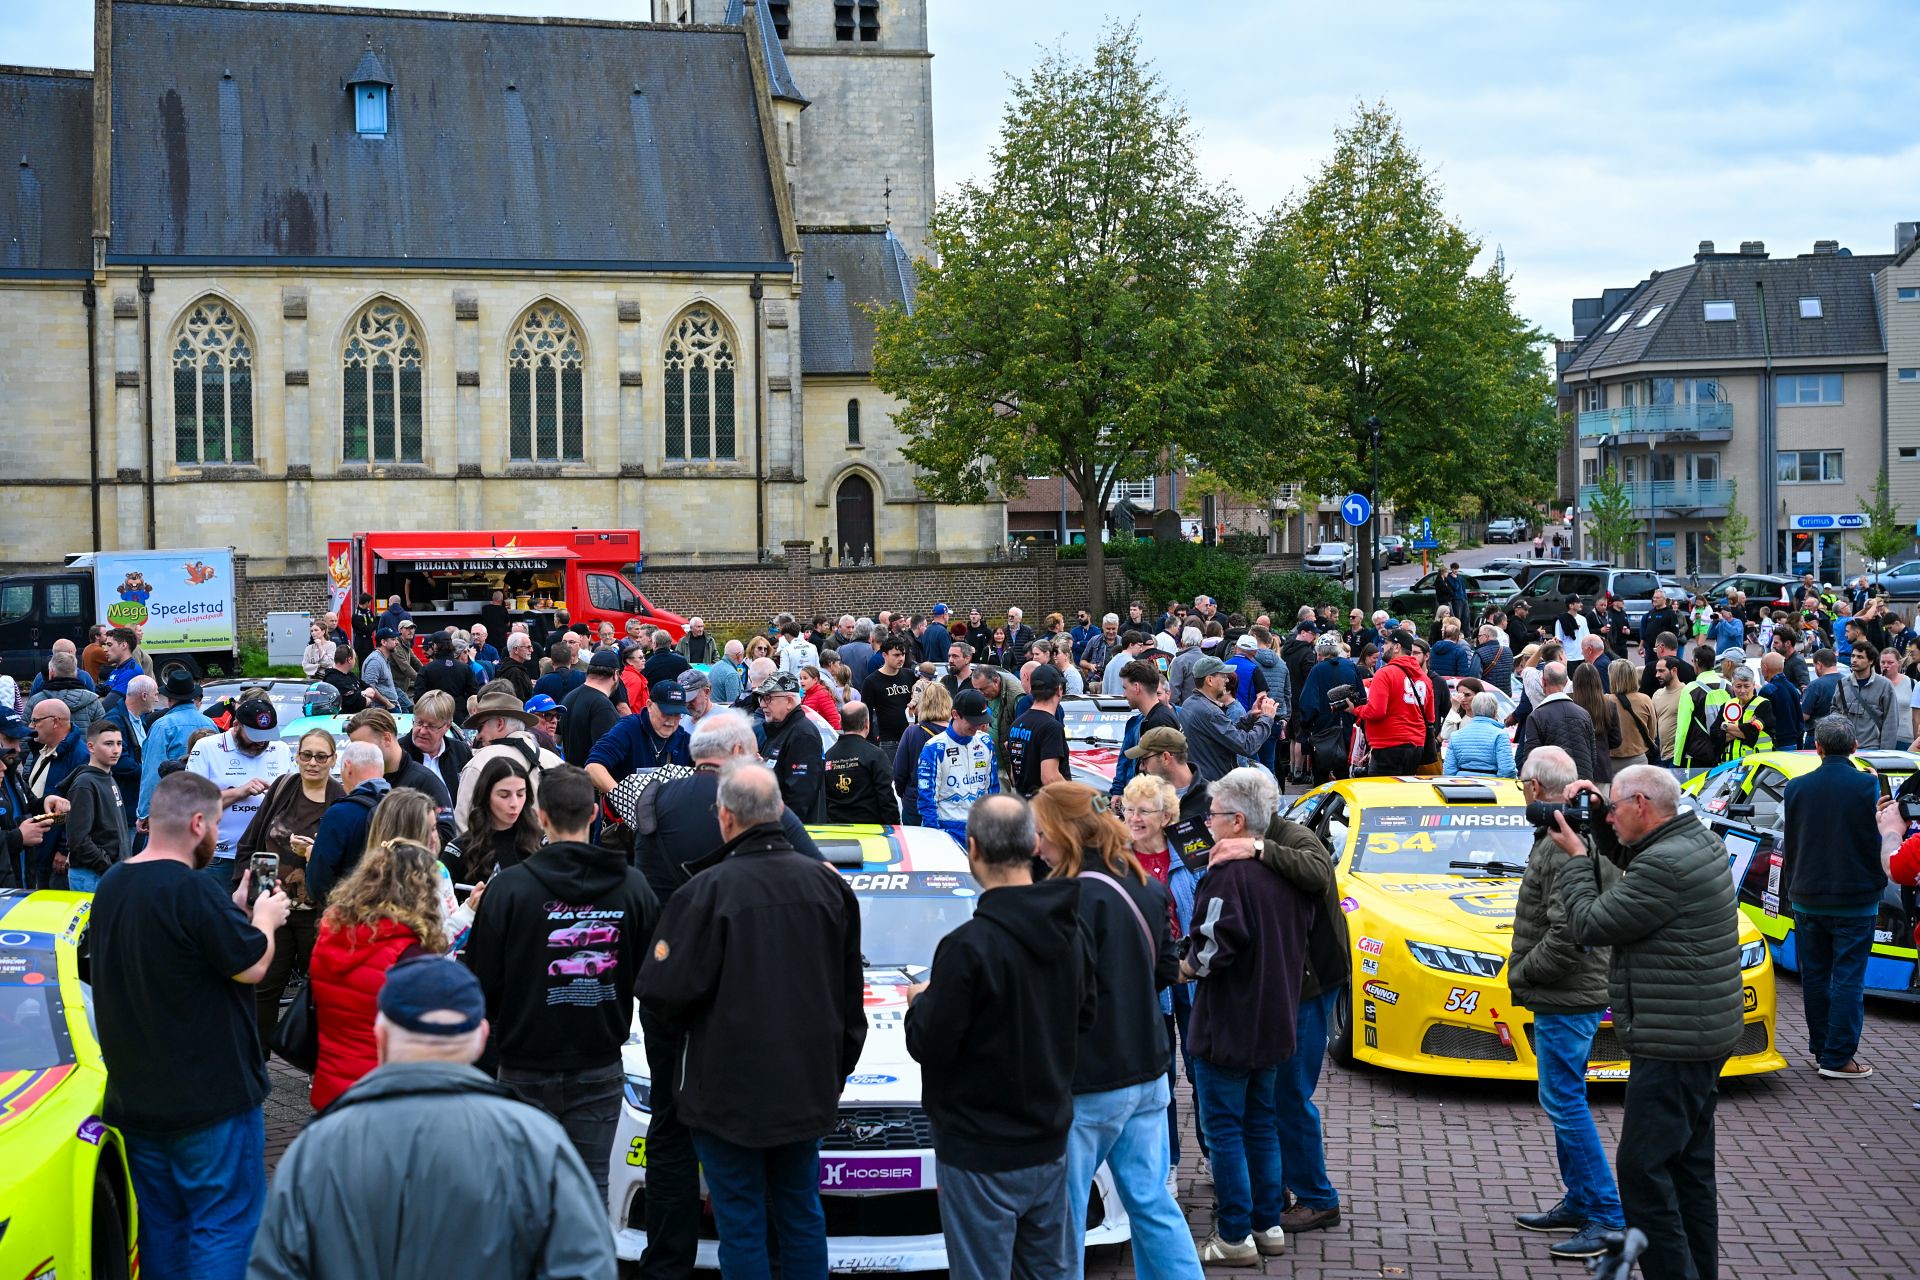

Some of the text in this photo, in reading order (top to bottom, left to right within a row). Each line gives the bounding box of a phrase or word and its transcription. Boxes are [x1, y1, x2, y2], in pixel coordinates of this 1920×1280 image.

[1424, 521, 1430, 537] P
[1802, 517, 1863, 526] primus wash
[414, 560, 548, 570] BELGIAN FRIES & SNACKS
[108, 600, 223, 620] Mega Speelstad
[1367, 832, 1437, 854] 54
[547, 911, 625, 920] RACING
[1358, 937, 1384, 955] Caval
[1366, 983, 1398, 1001] KENNOL
[1444, 987, 1480, 1014] 54
[850, 1074, 888, 1085] Ford
[846, 1168, 912, 1178] HOOSIER
